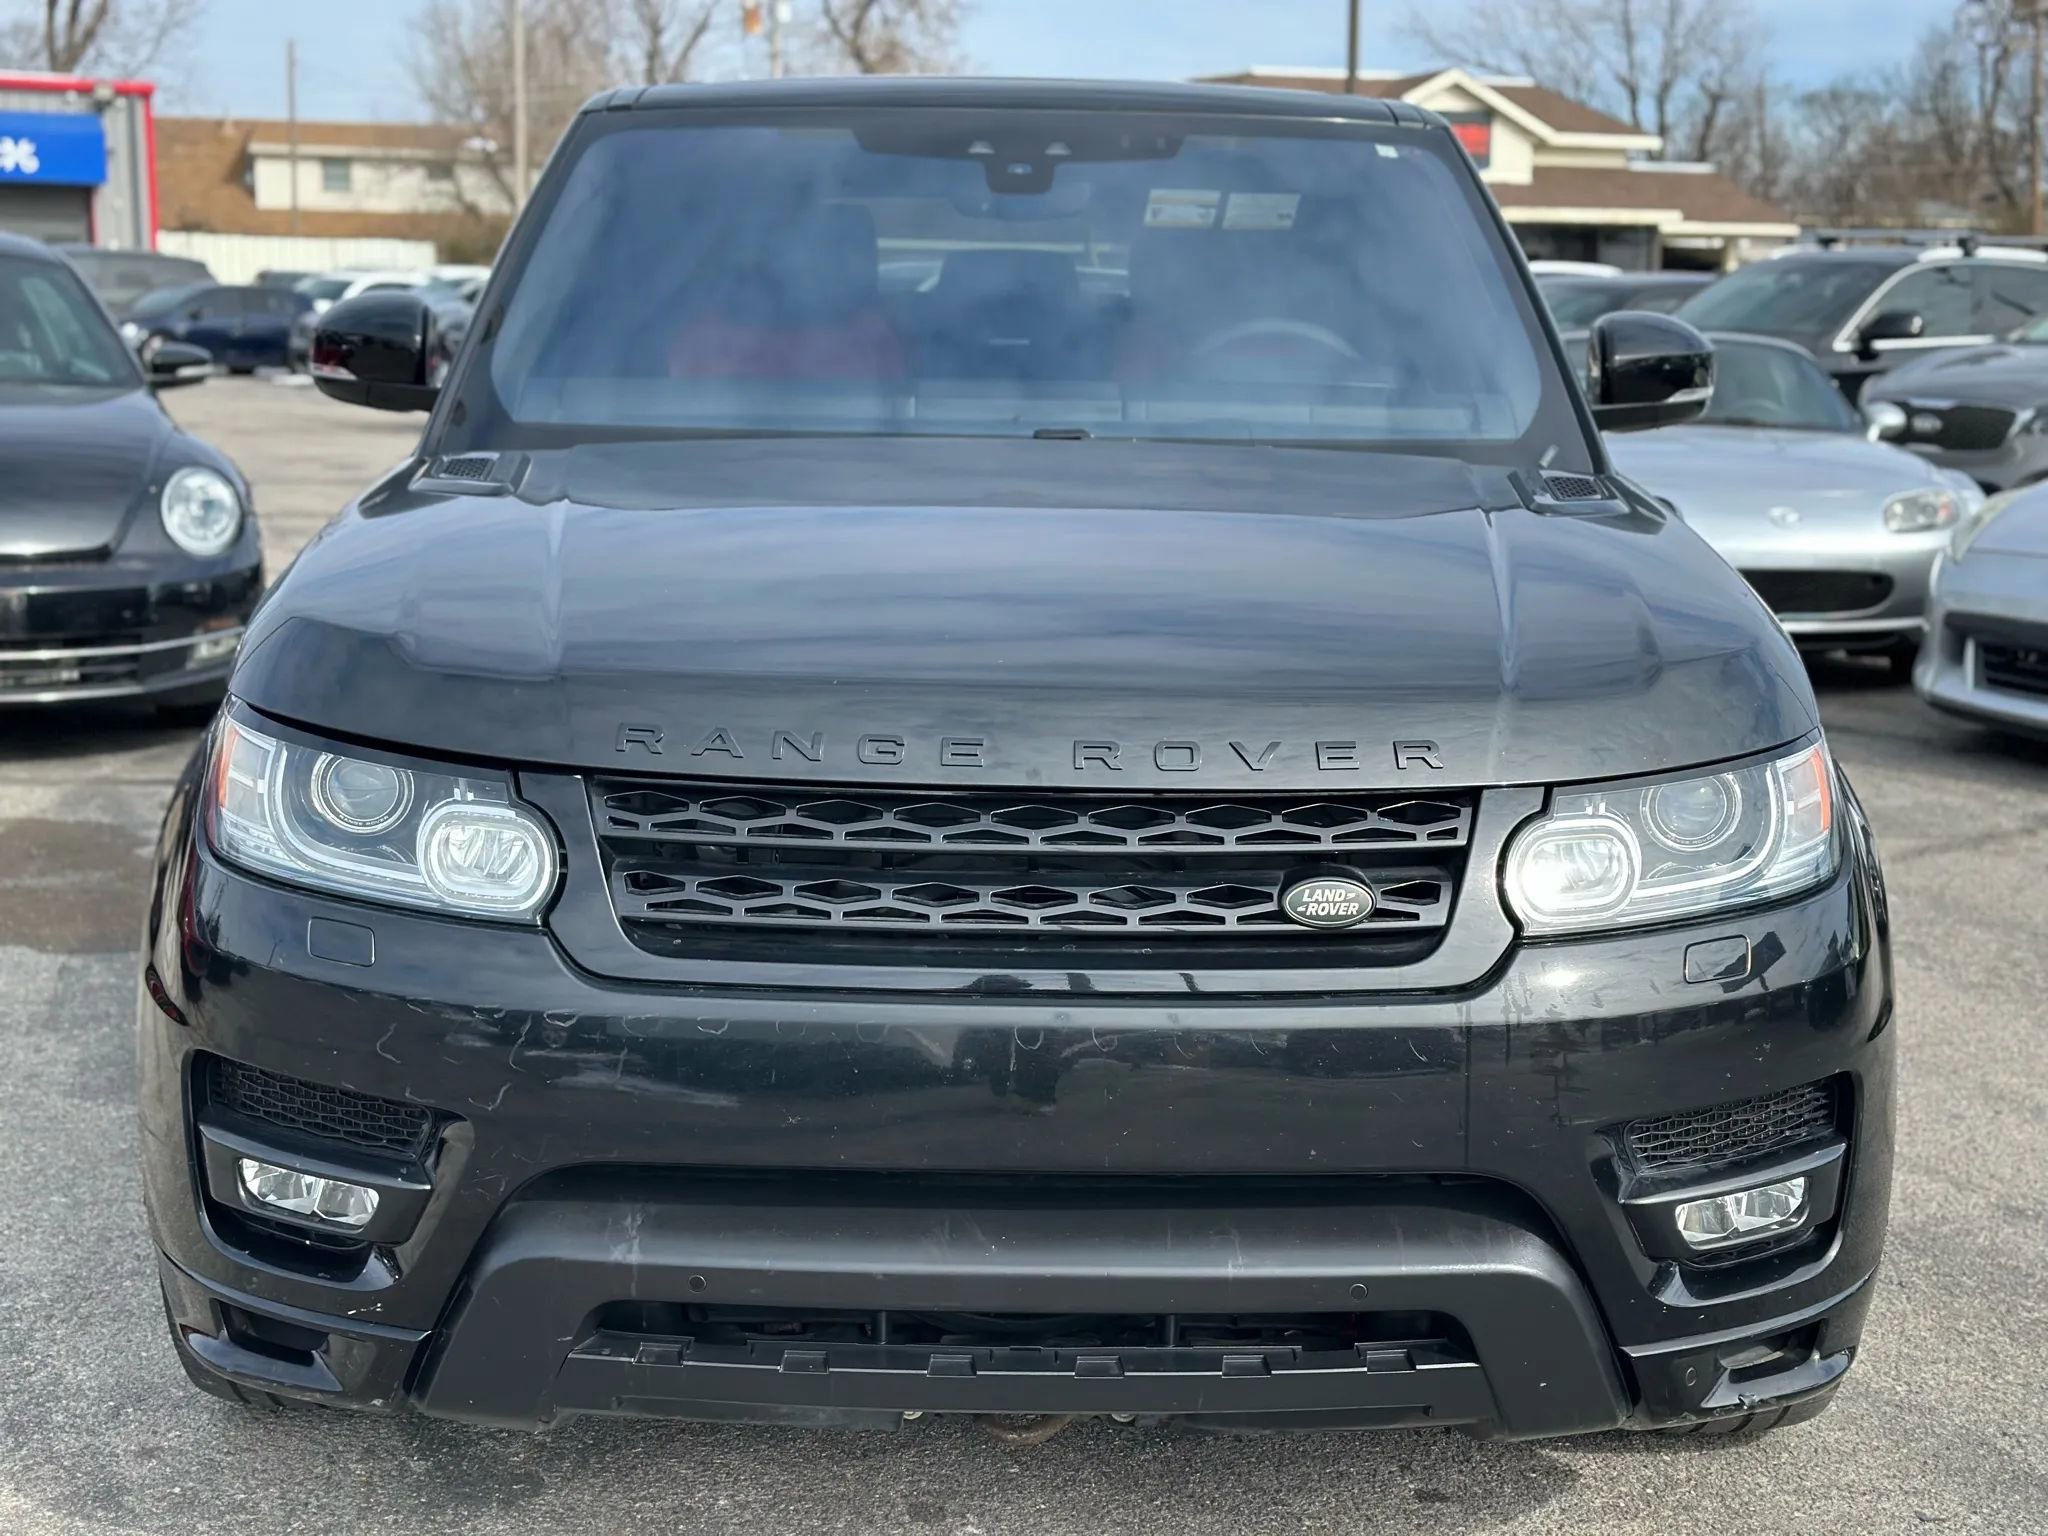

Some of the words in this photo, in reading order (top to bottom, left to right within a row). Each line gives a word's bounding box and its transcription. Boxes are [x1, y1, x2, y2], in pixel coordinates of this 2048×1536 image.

[615, 722, 984, 767] RANGE
[1073, 739, 1444, 771] ROVER
[1302, 888, 1346, 902] LAND
[1306, 902, 1359, 915] ROVER
